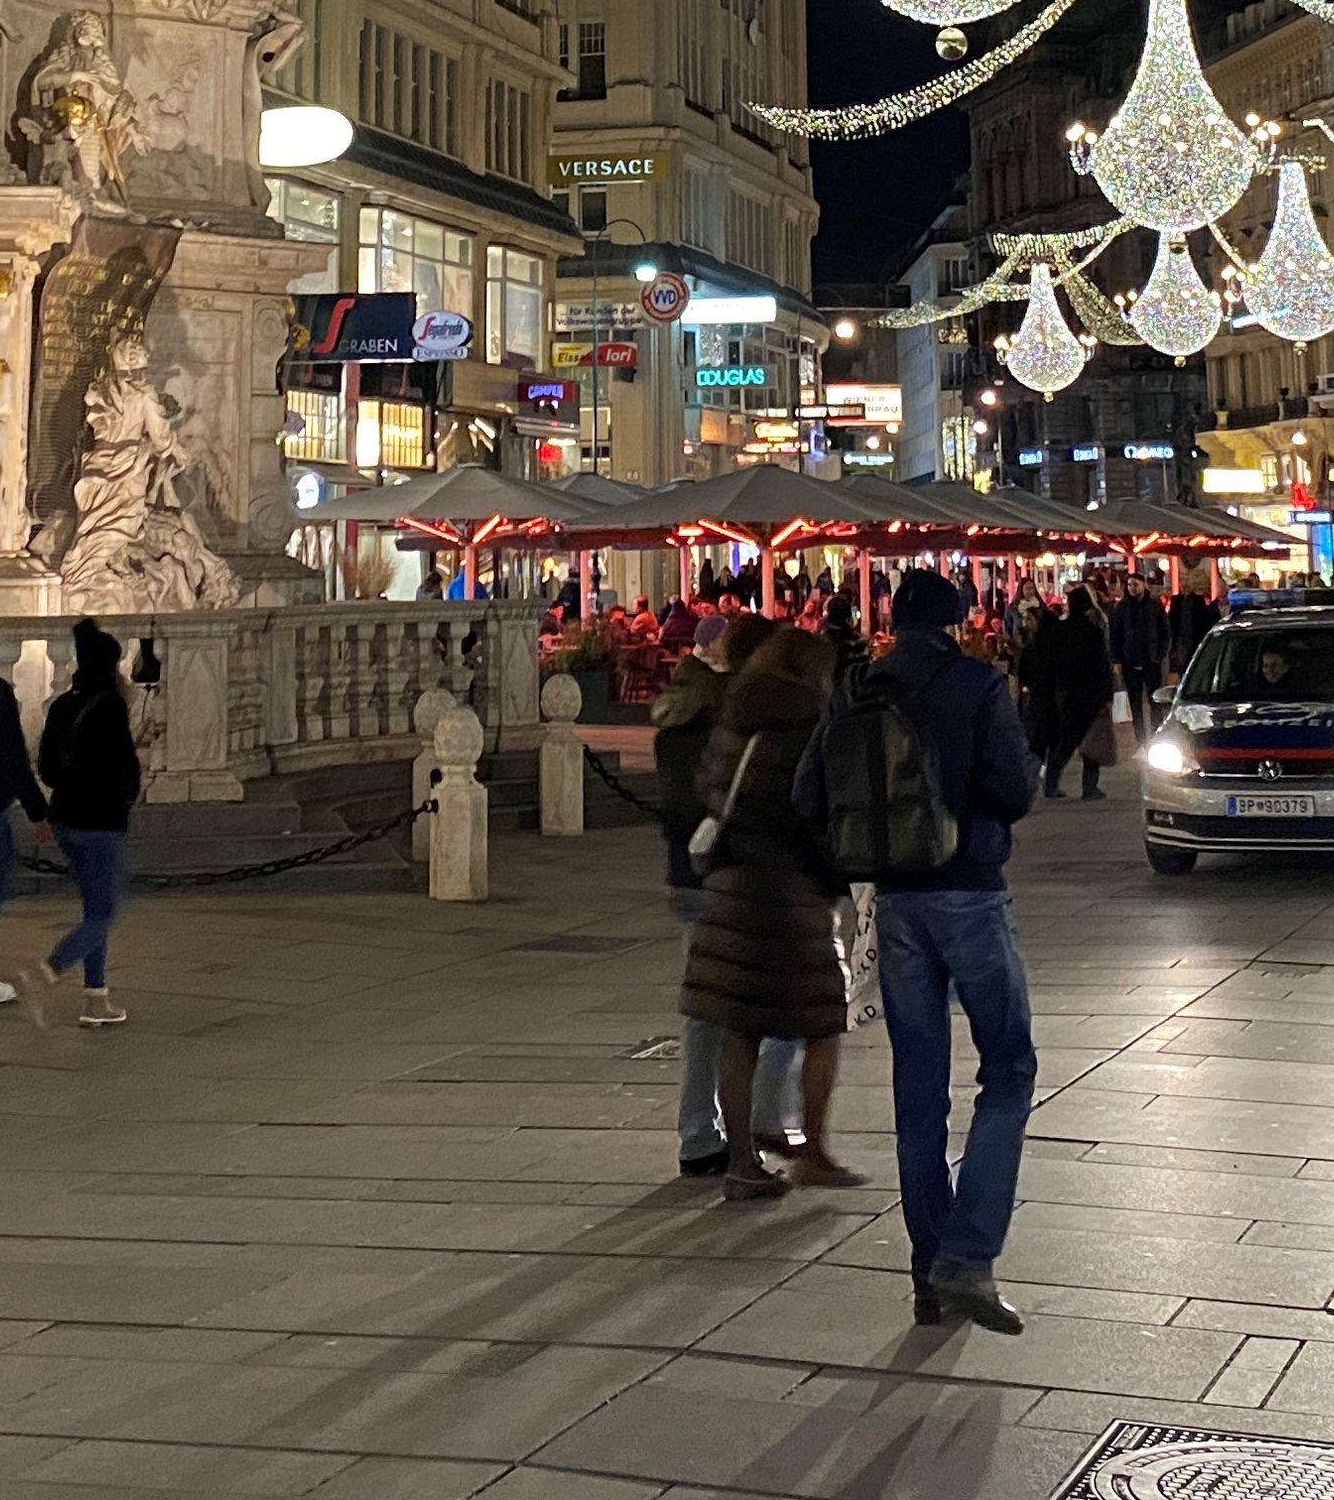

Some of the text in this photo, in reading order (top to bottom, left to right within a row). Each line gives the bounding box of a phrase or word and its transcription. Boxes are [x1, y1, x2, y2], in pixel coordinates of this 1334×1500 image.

[559, 159, 654, 176] VERSACE
[339, 338, 398, 353] GRABEN
[696, 368, 765, 385] DOUGLAS
[1239, 799, 1307, 813] BP 90379
